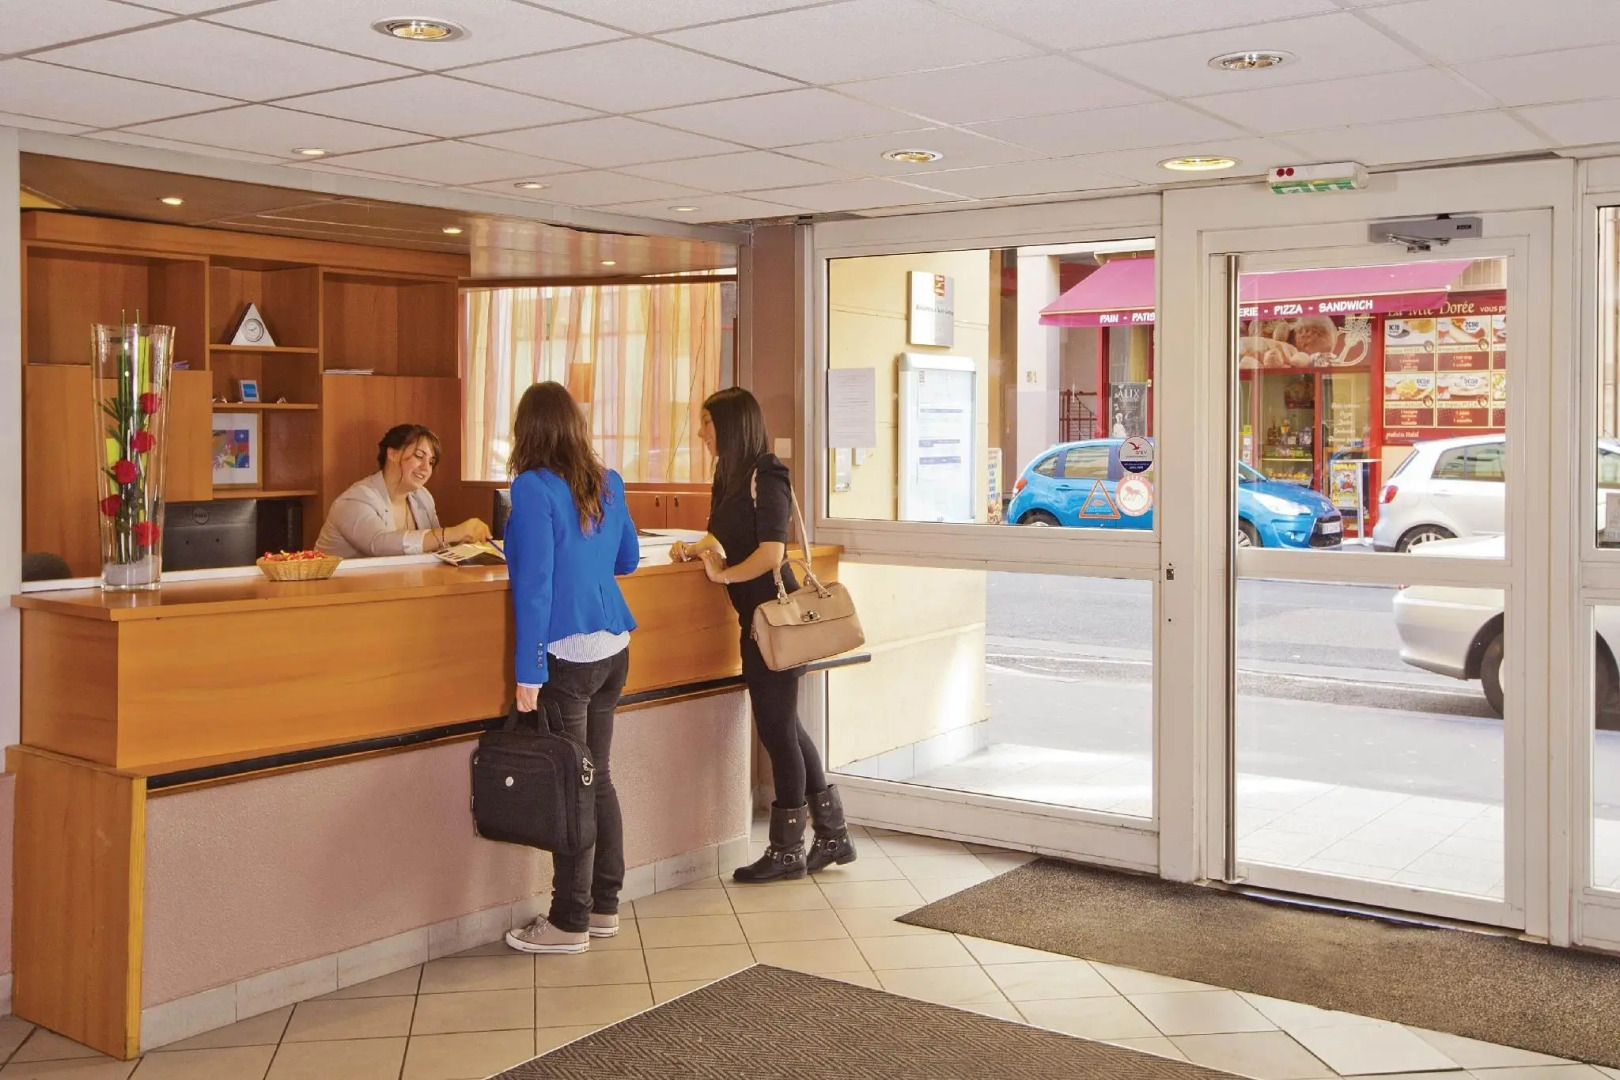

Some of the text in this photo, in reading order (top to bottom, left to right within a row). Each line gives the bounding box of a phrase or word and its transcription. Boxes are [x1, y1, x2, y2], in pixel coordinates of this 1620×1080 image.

[1100, 314, 1119, 323] PAIN
[1274, 304, 1303, 315] PIZZA
[1319, 300, 1373, 313] SANDWICH
[1440, 301, 1475, 314] Dorée
[1118, 388, 1140, 398] ALIX
